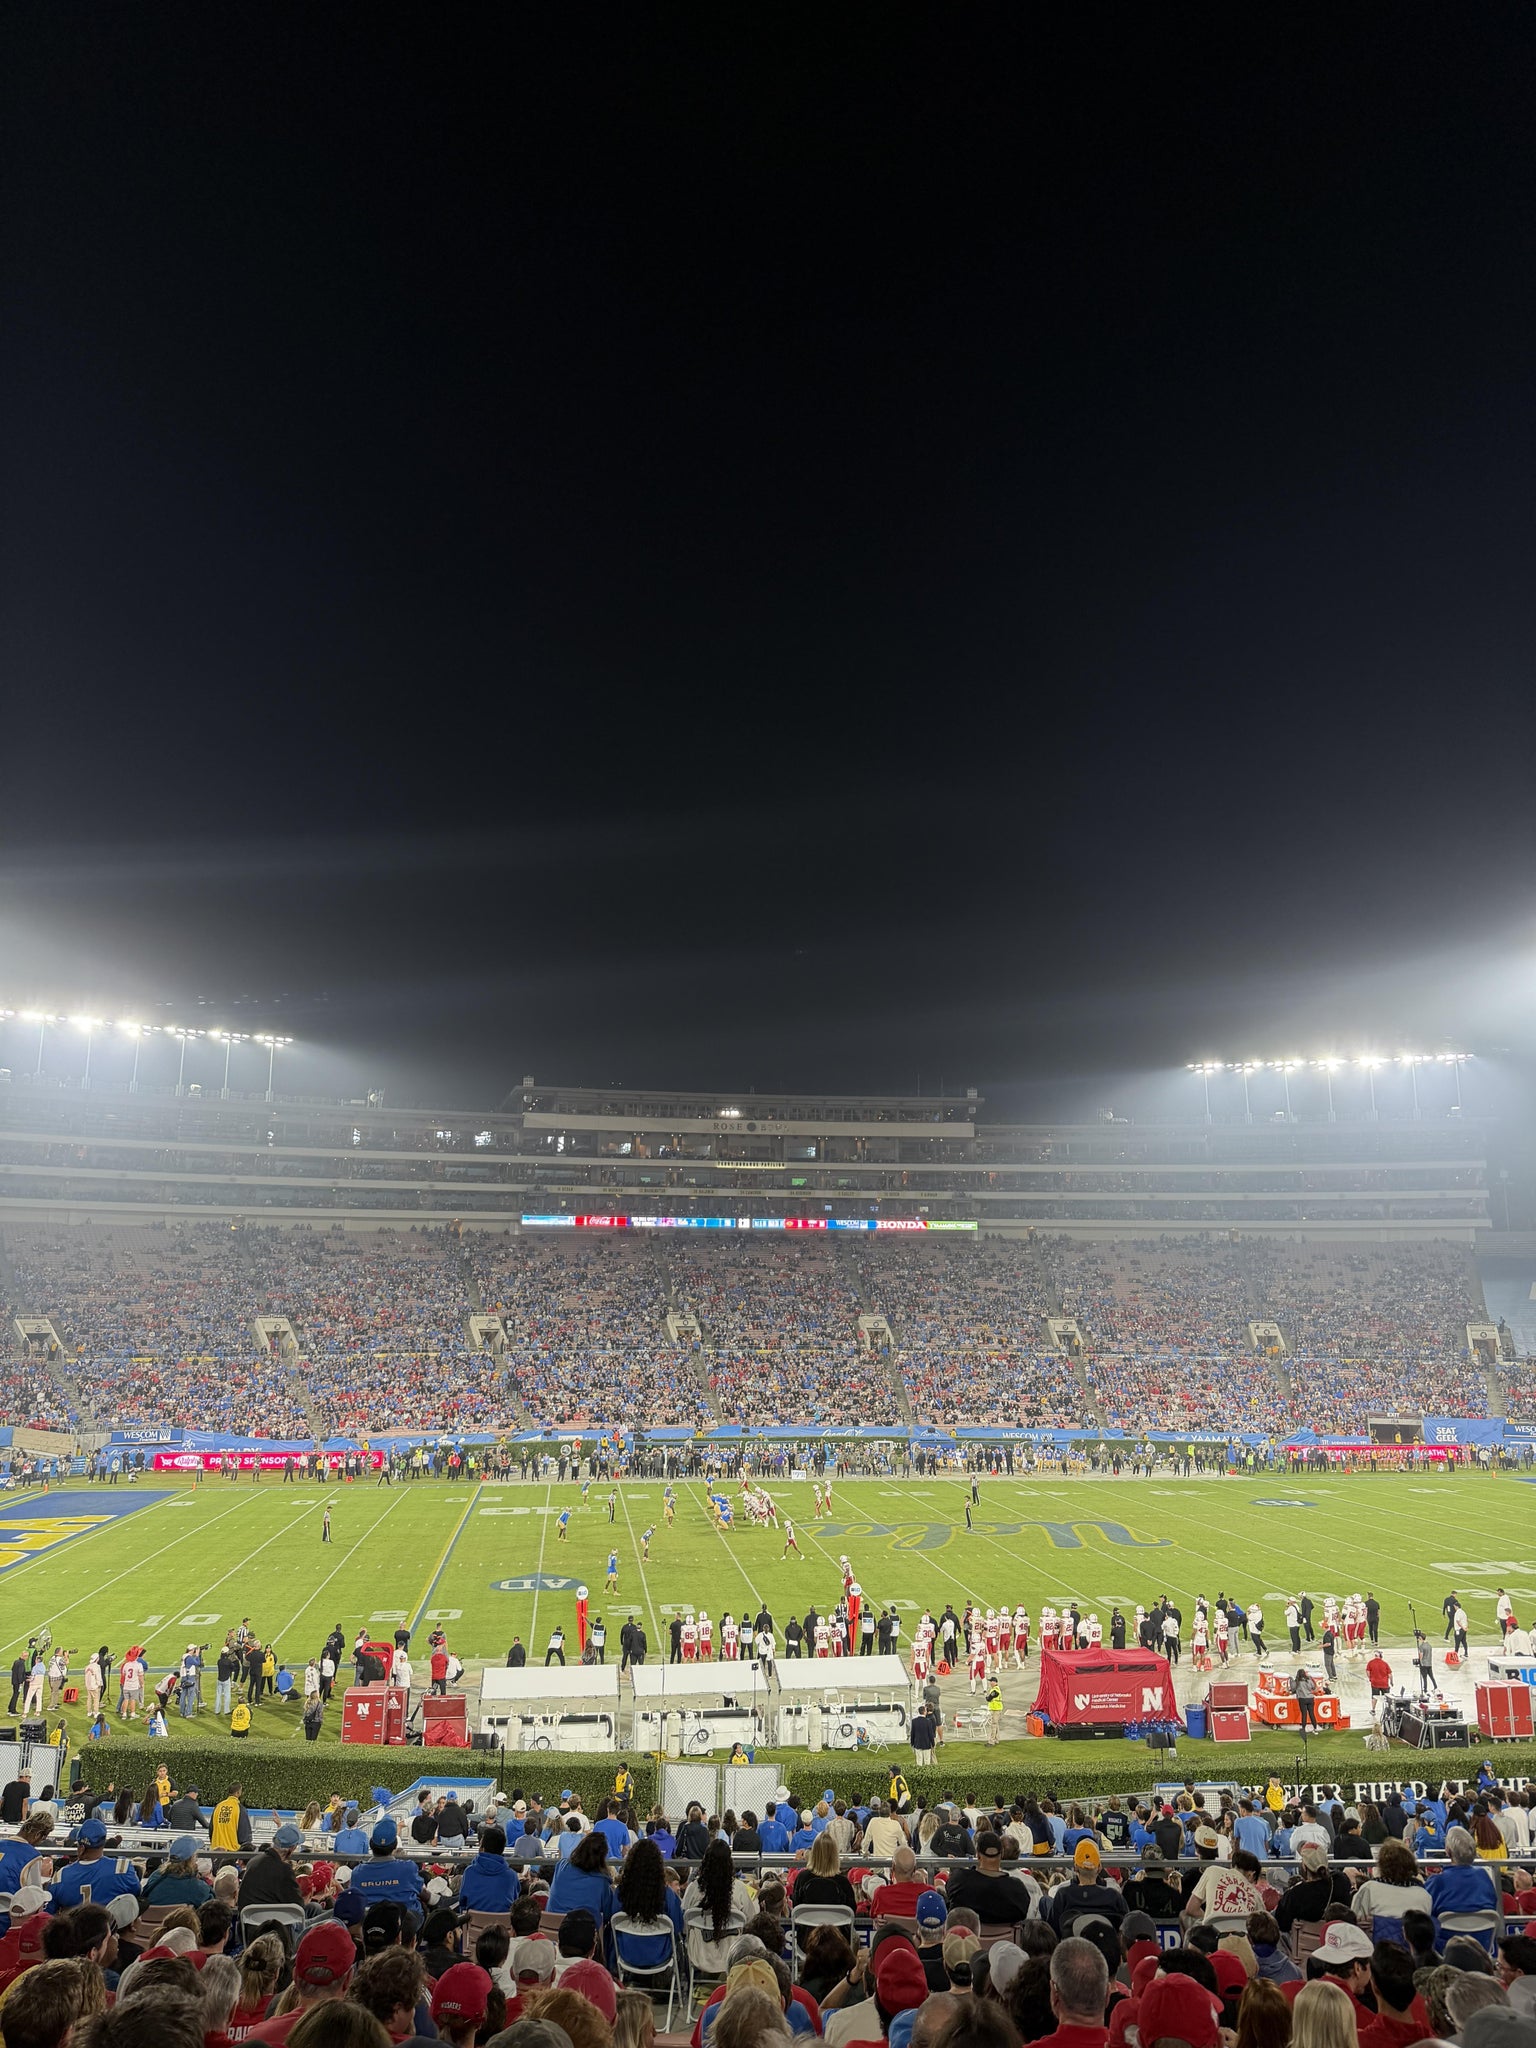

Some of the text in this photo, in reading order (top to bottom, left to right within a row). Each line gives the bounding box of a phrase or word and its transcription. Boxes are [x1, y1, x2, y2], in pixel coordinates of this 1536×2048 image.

[713, 1122, 742, 1130] ROSE
[877, 1221, 926, 1229] HONDA
[124, 1431, 158, 1439] WESCOM
[1002, 1432, 1039, 1440] WESCOM
[607, 1604, 696, 1616] 30
[139, 1614, 223, 1626] 10
[368, 1610, 463, 1622] 20
[701, 1626, 710, 1636] 18
[915, 1648, 926, 1658] 37
[938, 1662, 947, 1673] 40
[127, 1668, 135, 1679] 3
[1142, 1687, 1163, 1713] N
[357, 1702, 370, 1715] N
[1274, 1702, 1288, 1719] G
[1318, 1701, 1332, 1718] G
[1353, 1782, 1428, 1802] FIELD
[1106, 1824, 1123, 1840] 54
[361, 1879, 400, 1887] BRUINS
[80, 1884, 92, 1905] 1
[441, 2001, 462, 2011] HUSKERS
